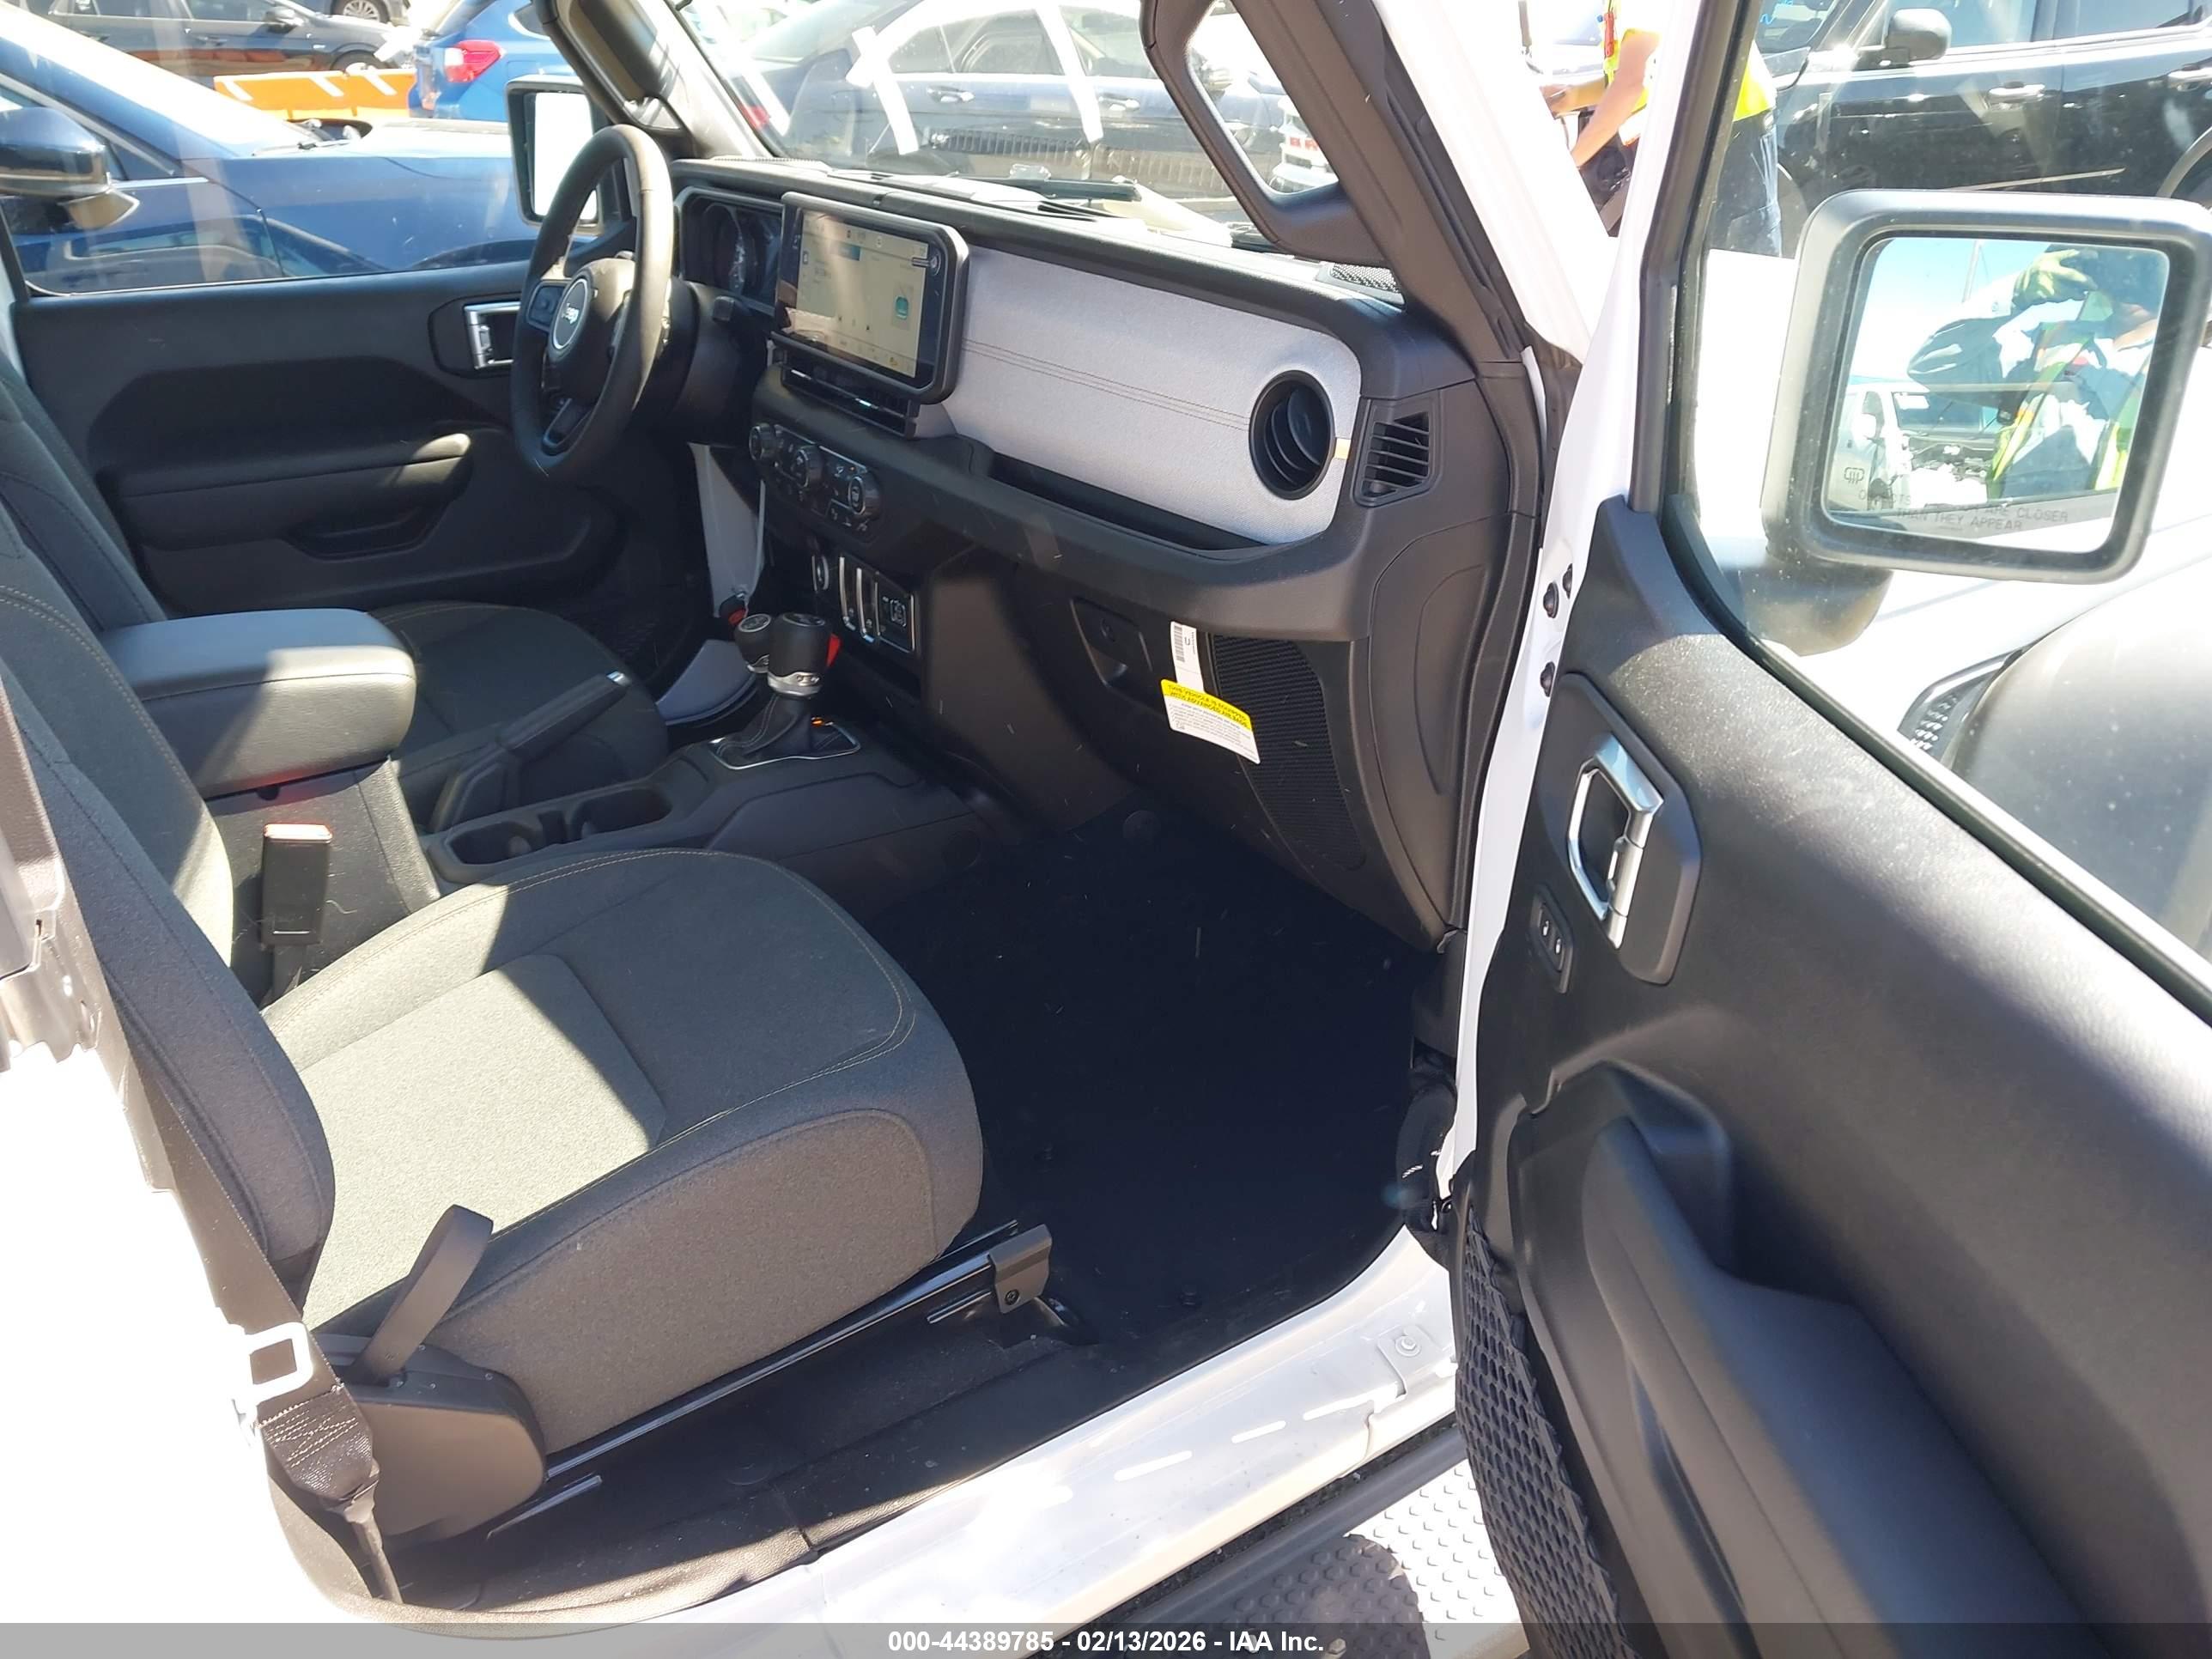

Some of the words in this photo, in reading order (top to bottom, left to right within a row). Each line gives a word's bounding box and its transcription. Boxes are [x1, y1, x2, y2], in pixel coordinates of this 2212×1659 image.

[1935, 514, 1964, 524] THEY
[1971, 516, 2021, 530] APPEAR
[2017, 507, 2069, 523] CLOSER
